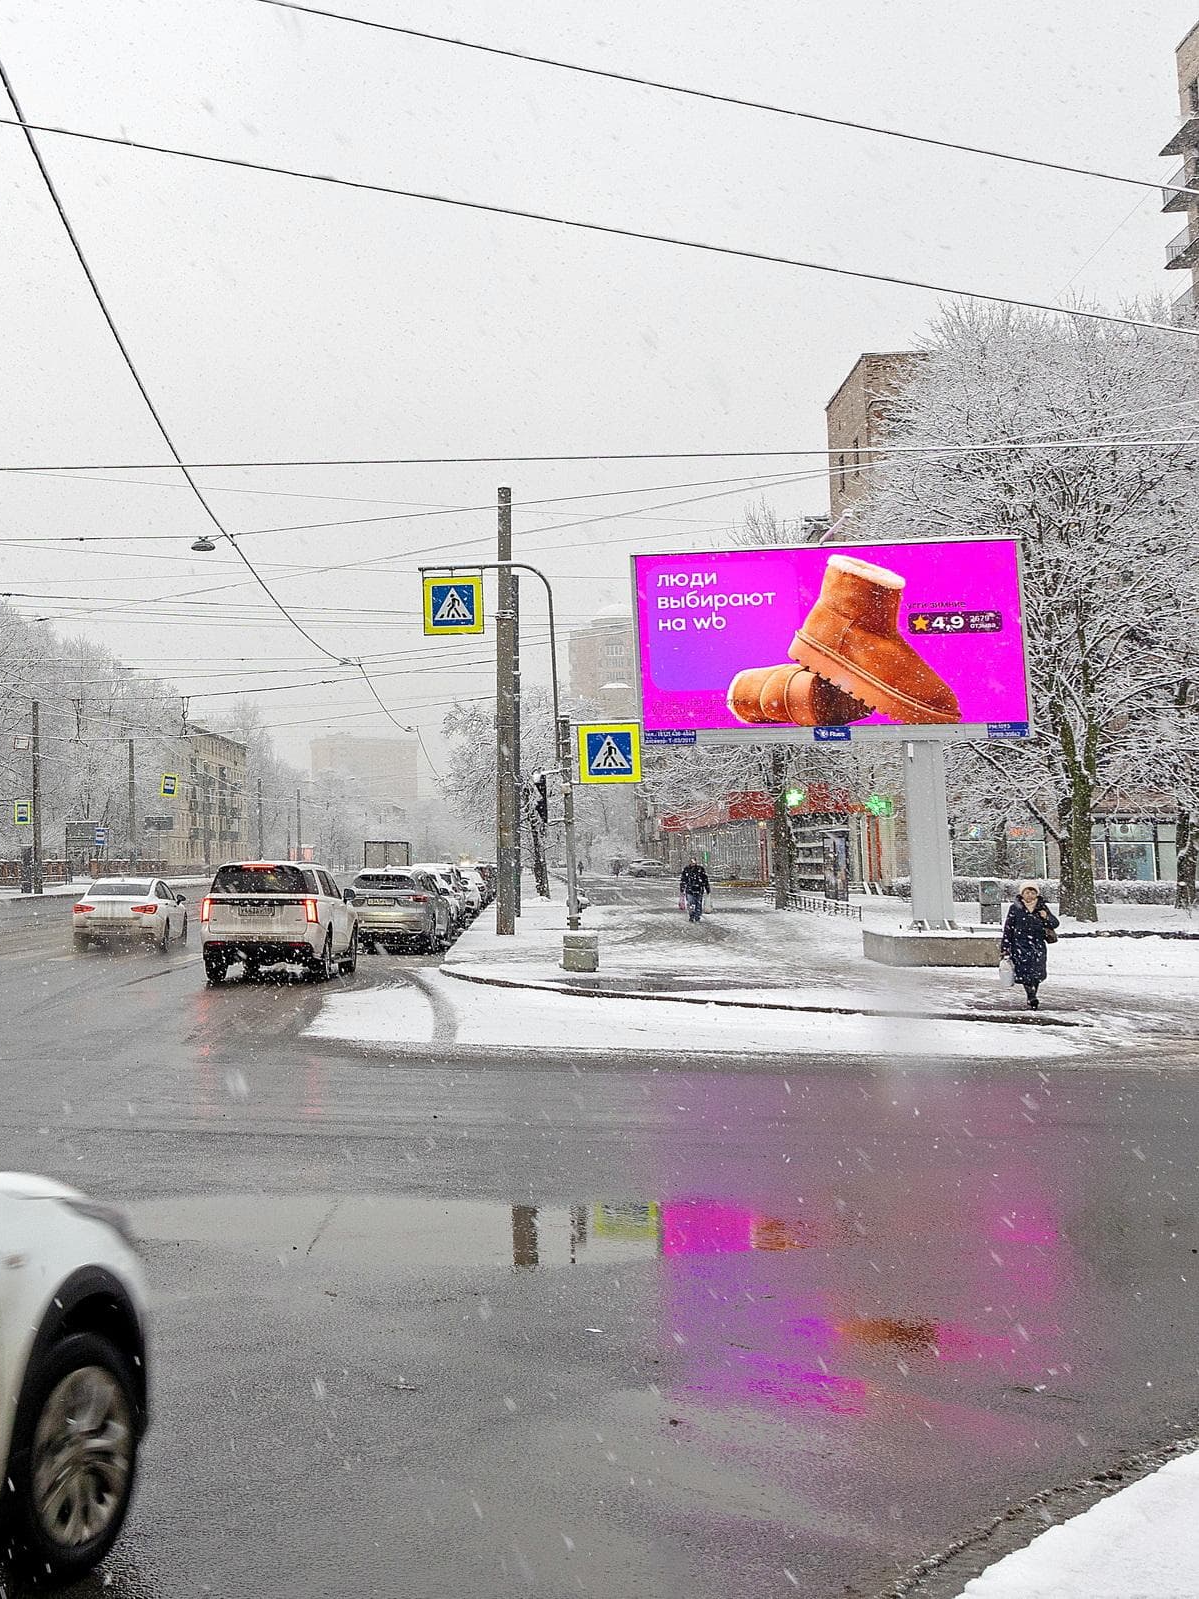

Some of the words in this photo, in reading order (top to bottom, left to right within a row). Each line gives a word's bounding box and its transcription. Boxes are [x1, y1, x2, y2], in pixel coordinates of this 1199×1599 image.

[657, 572, 718, 588] люди
[657, 590, 777, 611] выбирают
[658, 617, 687, 631] на
[692, 611, 727, 630] wb
[931, 615, 964, 631] 4,9
